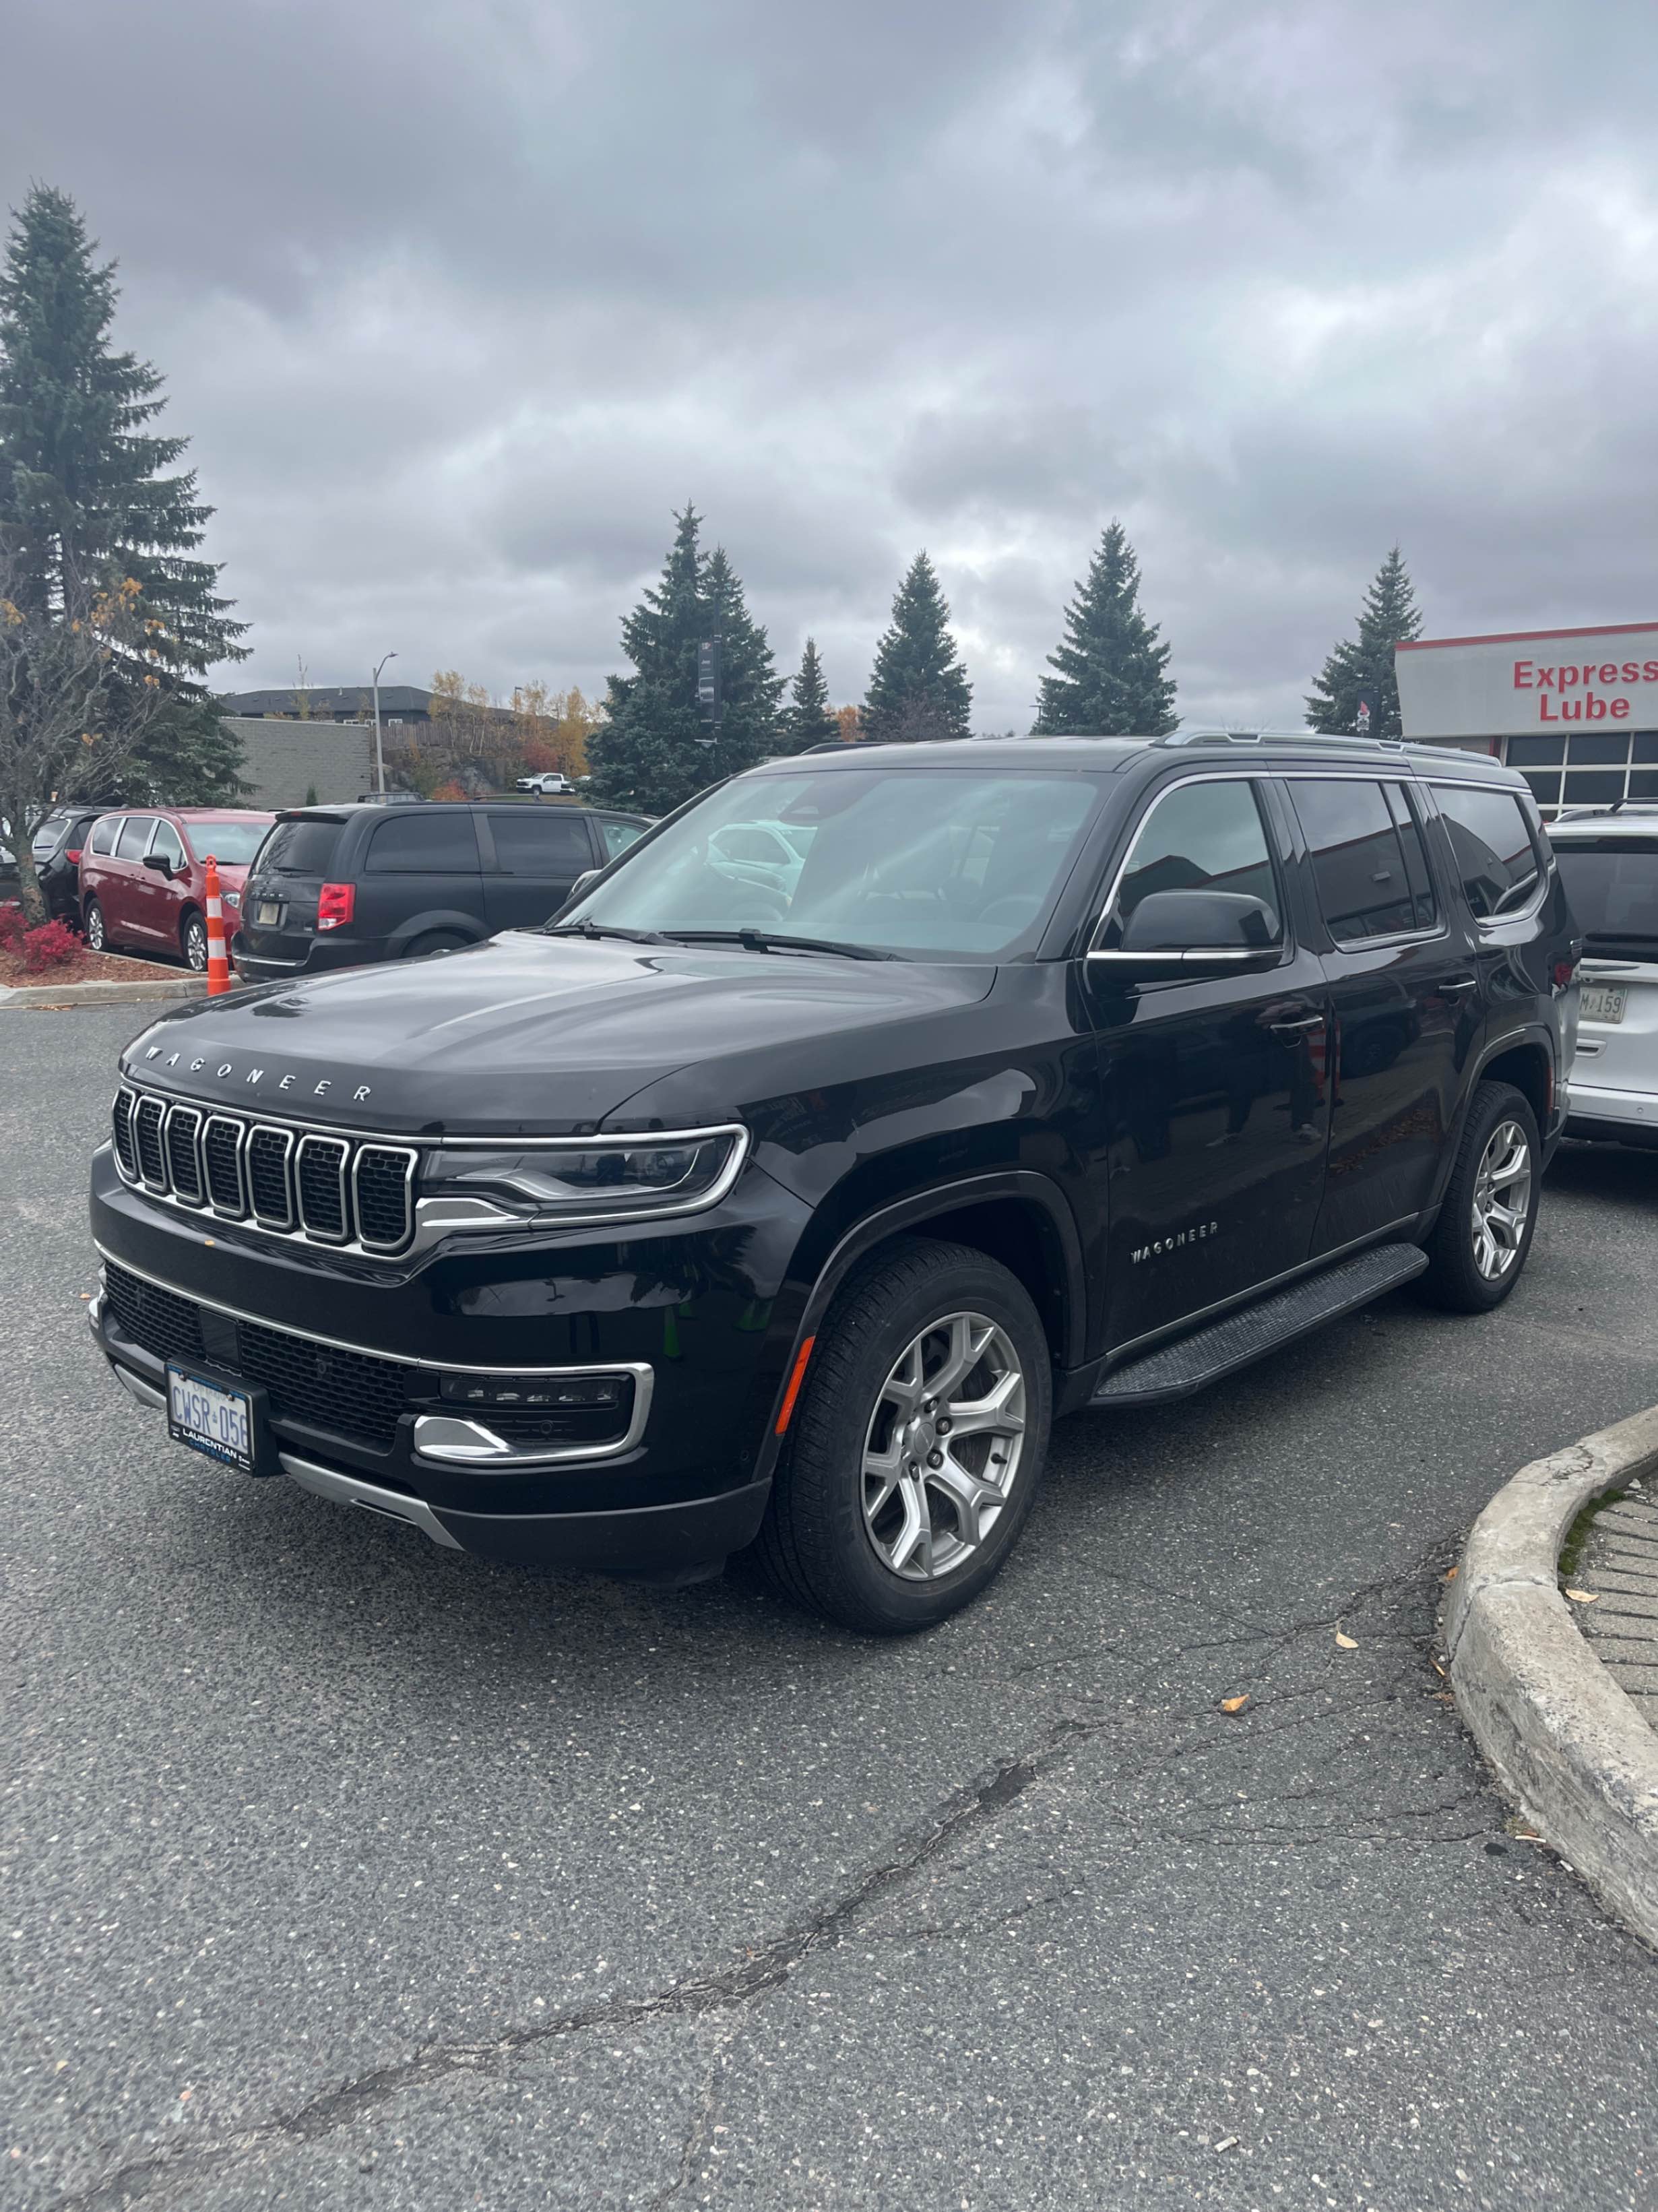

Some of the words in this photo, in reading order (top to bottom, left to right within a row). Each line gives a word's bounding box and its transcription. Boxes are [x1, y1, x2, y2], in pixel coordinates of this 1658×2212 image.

[1514, 660, 1658, 693] Express
[1539, 691, 1630, 722] Lube
[145, 1046, 371, 1102] WAGONEER
[1130, 1221, 1218, 1264] WAGONEER
[182, 1427, 238, 1460] LAURENTIAN
